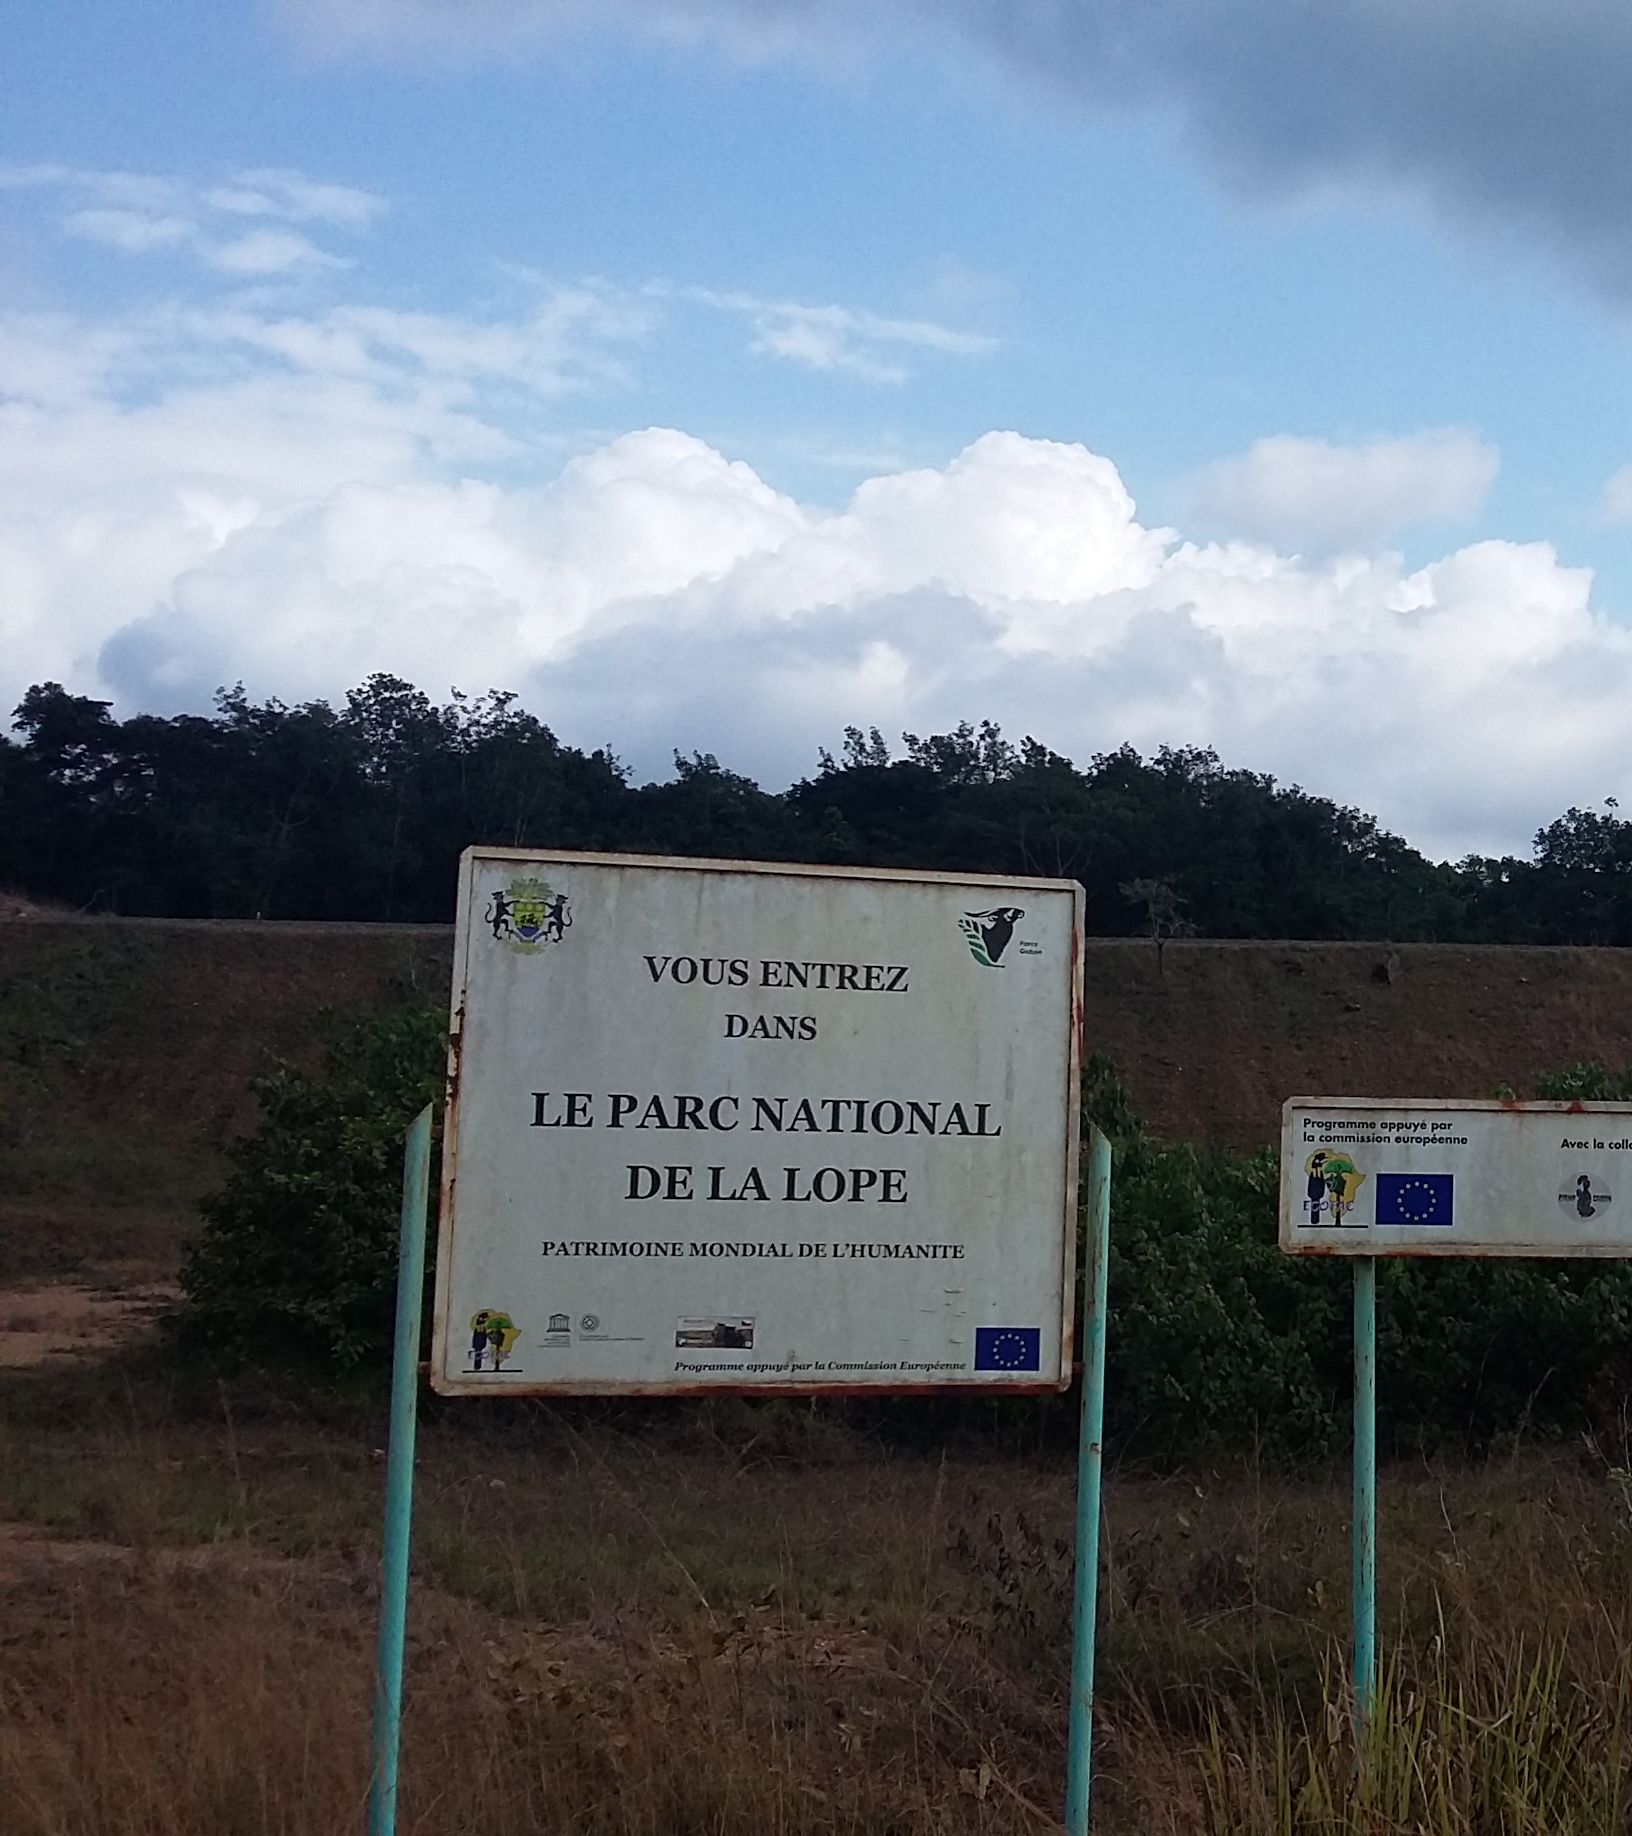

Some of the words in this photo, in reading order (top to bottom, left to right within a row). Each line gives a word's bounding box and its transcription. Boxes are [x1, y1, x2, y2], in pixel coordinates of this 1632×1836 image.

[642, 955, 750, 987] VOUS
[758, 960, 909, 992] ENTREZ
[723, 1013, 817, 1041] DANS
[529, 1092, 594, 1128] LE
[605, 1094, 739, 1131] PARC
[750, 1097, 1002, 1137] NATIONAL
[1303, 1118, 1376, 1131] Programme
[1380, 1120, 1427, 1133] appuyé
[1430, 1122, 1453, 1133] par
[1303, 1131, 1315, 1143] la
[1318, 1133, 1391, 1144] commission
[1394, 1133, 1468, 1147] européenne
[1560, 1138, 1589, 1150] Avec
[1593, 1138, 1605, 1150] la
[624, 1165, 694, 1200] DE
[706, 1166, 771, 1201] LA
[781, 1167, 908, 1203] LOPE
[541, 1241, 684, 1257] PATRIMOINE
[688, 1242, 794, 1258] MONDIAL
[798, 1243, 827, 1258] DE
[674, 1361, 744, 1373] Programme
[746, 1361, 789, 1373] appuyé
[790, 1362, 813, 1373] par
[814, 1361, 826, 1371] la
[827, 1360, 897, 1371] Commission
[899, 1360, 966, 1373] Européenne
